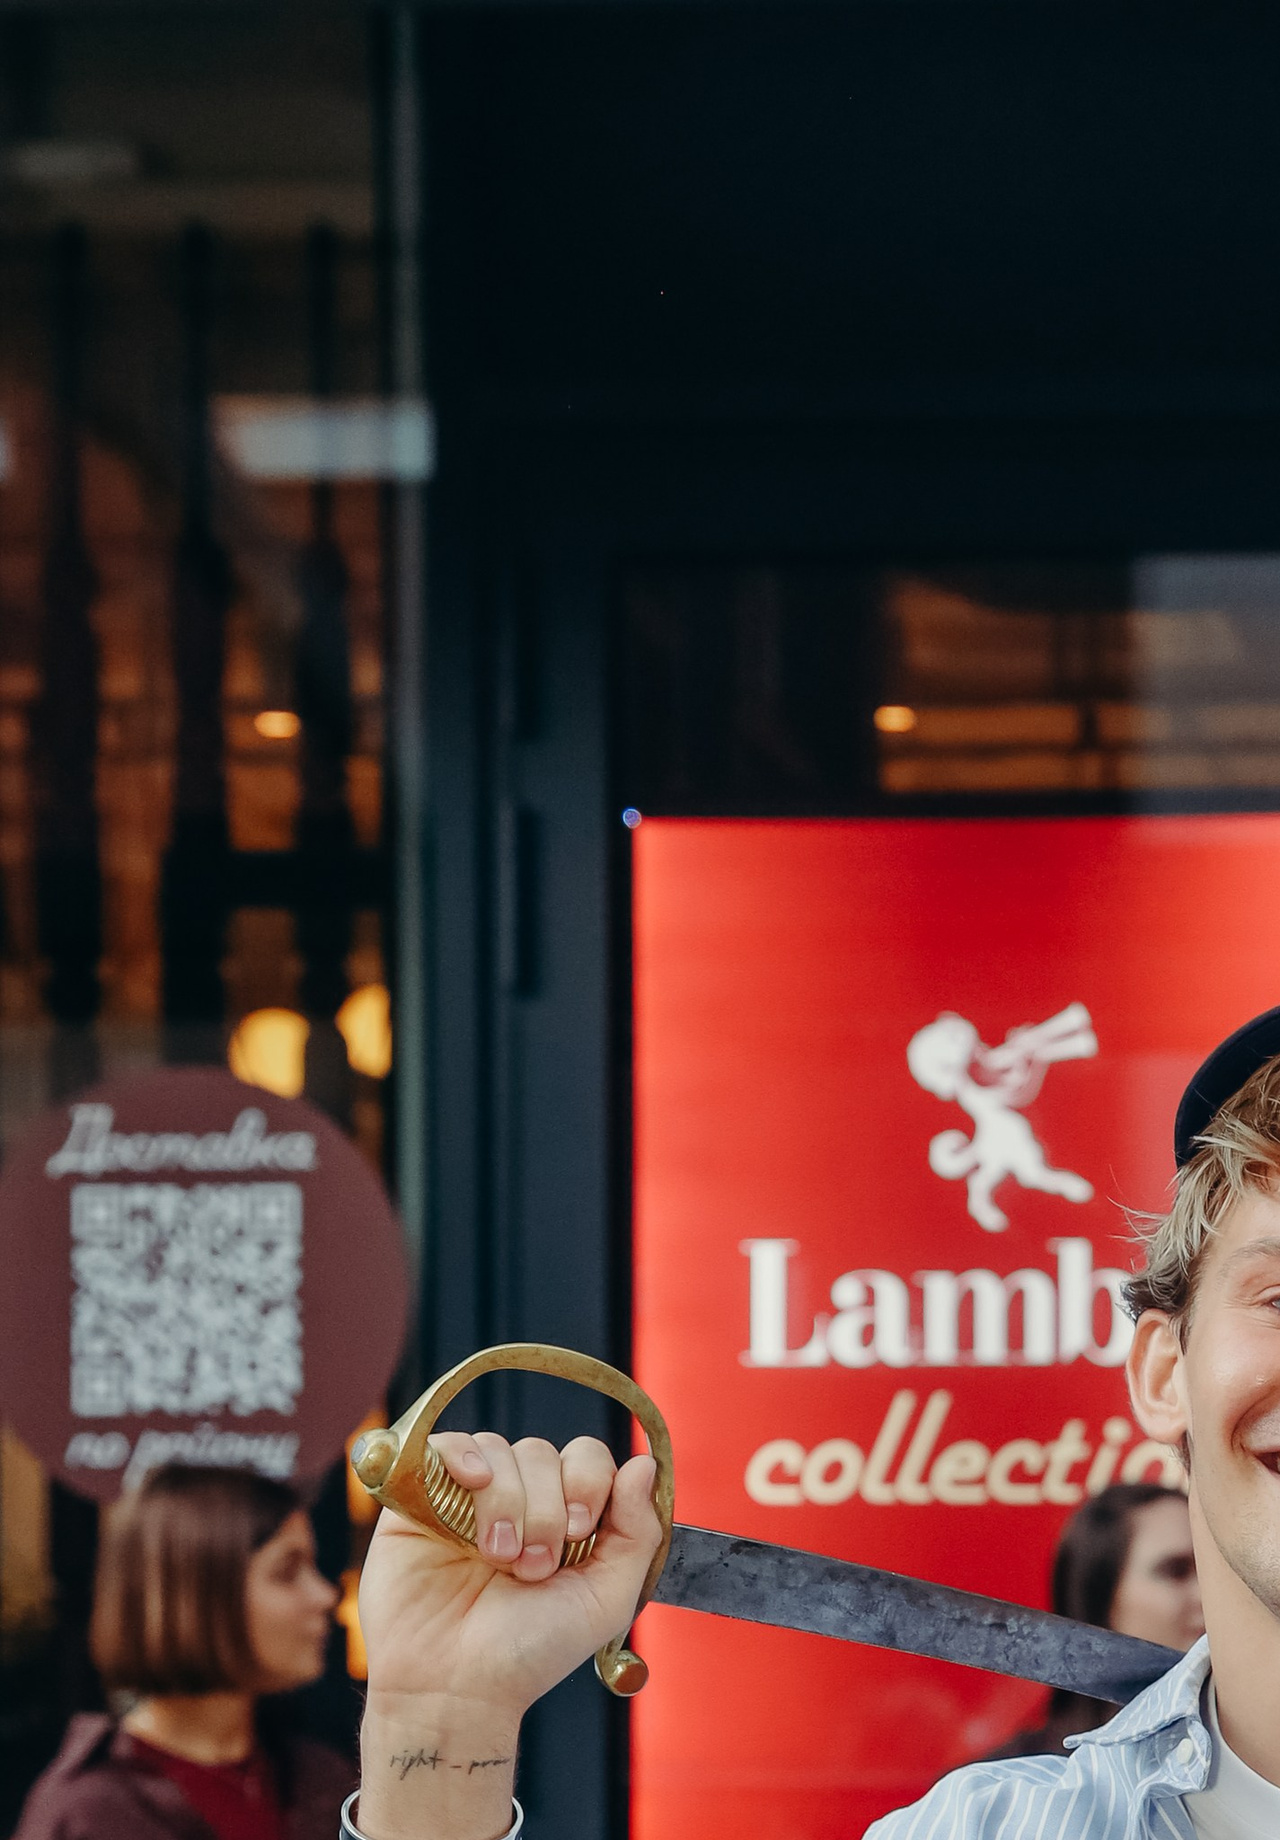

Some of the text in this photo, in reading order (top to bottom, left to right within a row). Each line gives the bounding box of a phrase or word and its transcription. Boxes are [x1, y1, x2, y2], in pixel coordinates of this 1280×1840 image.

[738, 1237, 1136, 1368] Lamb
[744, 1388, 1189, 1506] collectio
[390, 1748, 444, 1781] right
